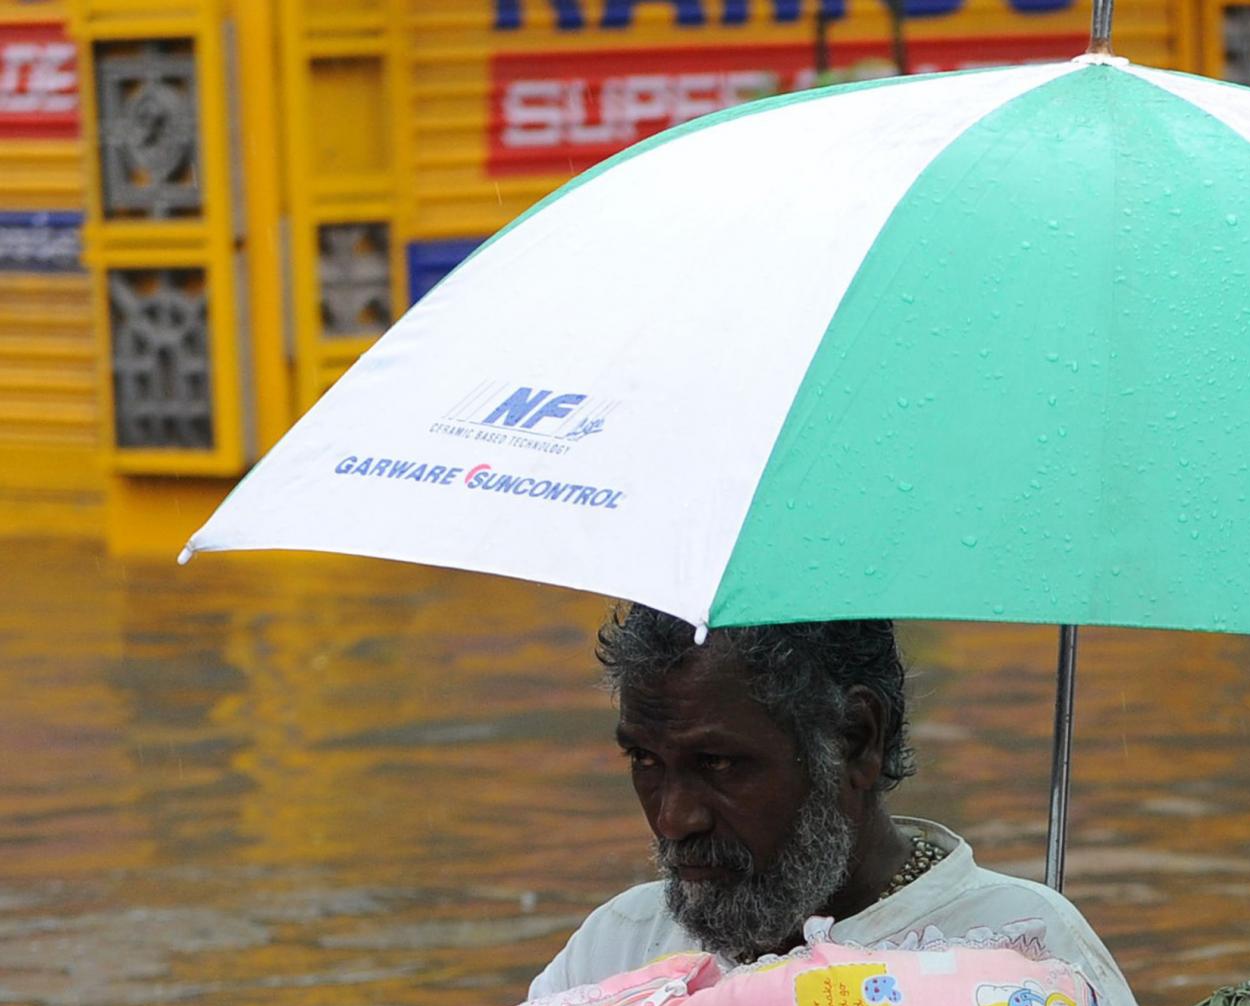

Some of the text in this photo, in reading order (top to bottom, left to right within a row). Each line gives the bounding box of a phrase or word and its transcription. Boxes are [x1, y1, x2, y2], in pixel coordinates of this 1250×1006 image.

[481, 387, 587, 429] NF
[429, 423, 571, 455] CERAMIC BASED TECHNOLOGY
[334, 456, 623, 509] GARWARE SUNCONTROL
[839, 982, 850, 997] go
